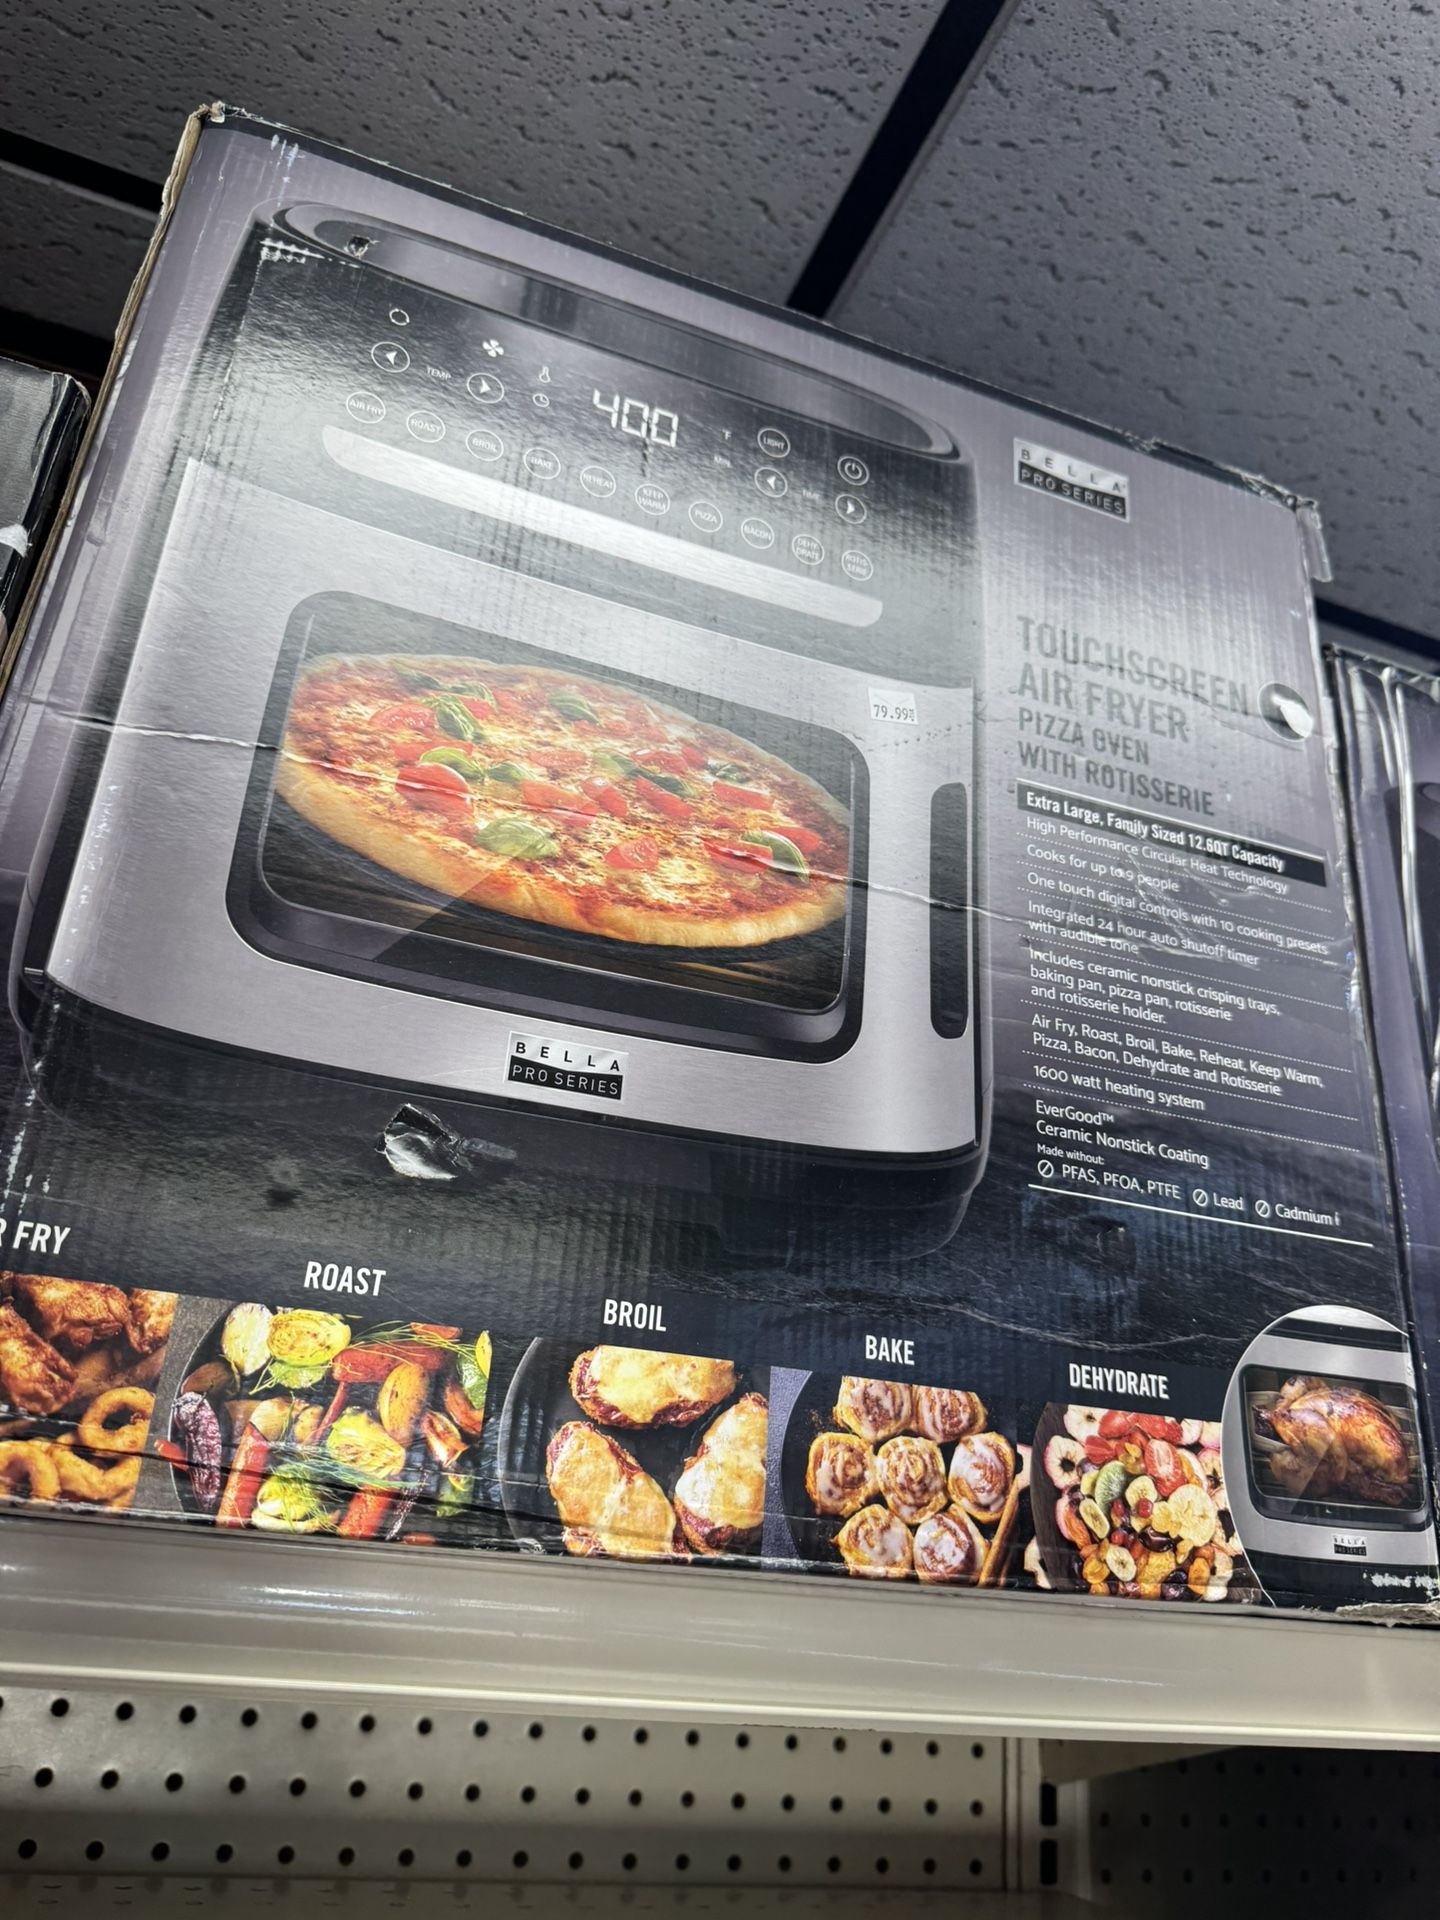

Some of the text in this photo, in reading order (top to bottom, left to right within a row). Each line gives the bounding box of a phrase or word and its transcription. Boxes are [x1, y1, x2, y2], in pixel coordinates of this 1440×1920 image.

[410, 418, 442, 434] ROAST
[592, 388, 679, 448] 400
[472, 437, 498, 453] BROIL
[763, 437, 785, 451] LIGHT
[1020, 448, 1125, 492] BELLA
[1021, 468, 1125, 515] PRO SERIES
[694, 509, 719, 524] PIZZA
[744, 526, 772, 541] BACON
[1017, 615, 1250, 716] TOUCHSCREEN
[873, 703, 909, 721] 79.99
[1017, 661, 1190, 744] AIR FRYER
[1018, 706, 1150, 765] PIZZA OVEN
[1018, 739, 1216, 817] WITH ROTISSERIE
[1026, 791, 1286, 873] Extra Large, Family Sized 12.6QT Capacity
[1026, 816, 1288, 895] High Performance Circular Heat Technology
[1026, 843, 1067, 865] Cooks
[1069, 853, 1088, 869] for
[1090, 861, 1107, 878] up
[1136, 871, 1181, 892] people
[1027, 871, 1329, 956] One touch digital controls with 10 cooking presets
[1027, 900, 1260, 967] Integrated 24 hour auto shutoff timer
[1028, 919, 1139, 955] with audible tone
[1029, 947, 1282, 1017] Includes ceramic nonstick crisping trays,
[1029, 965, 1234, 1023] baking pan, pizza pan, rotisserie
[1030, 983, 1168, 1026] and rotisserie holder.
[515, 1041, 620, 1072] BELLA
[1031, 1013, 1326, 1090] Air Fry, Roast, Broil, Bake, Reheat, Keep Warm,
[1032, 1032, 1283, 1097] Pizza, Bacon, Dehydrate and Rotisserie
[512, 1064, 619, 1096] PRO SERIES
[1033, 1065, 1206, 1112] 1600 watt heating system
[1035, 1120, 1210, 1169] Ceramic Nonstick Coating
[1036, 1143, 1106, 1166] Made without:
[1061, 1165, 1101, 1187] PFAS,
[1102, 1172, 1145, 1194] PFOA,
[1147, 1180, 1182, 1200] PTFE
[1212, 1192, 1245, 1212] Lead
[1274, 1203, 1334, 1226] Cadmium
[12, 1219, 71, 1255] FRY
[302, 1260, 387, 1297] ROAST
[602, 1298, 667, 1332] BROIL
[864, 1334, 915, 1366] BAKE
[1068, 1362, 1171, 1400] DEHYDRATE
